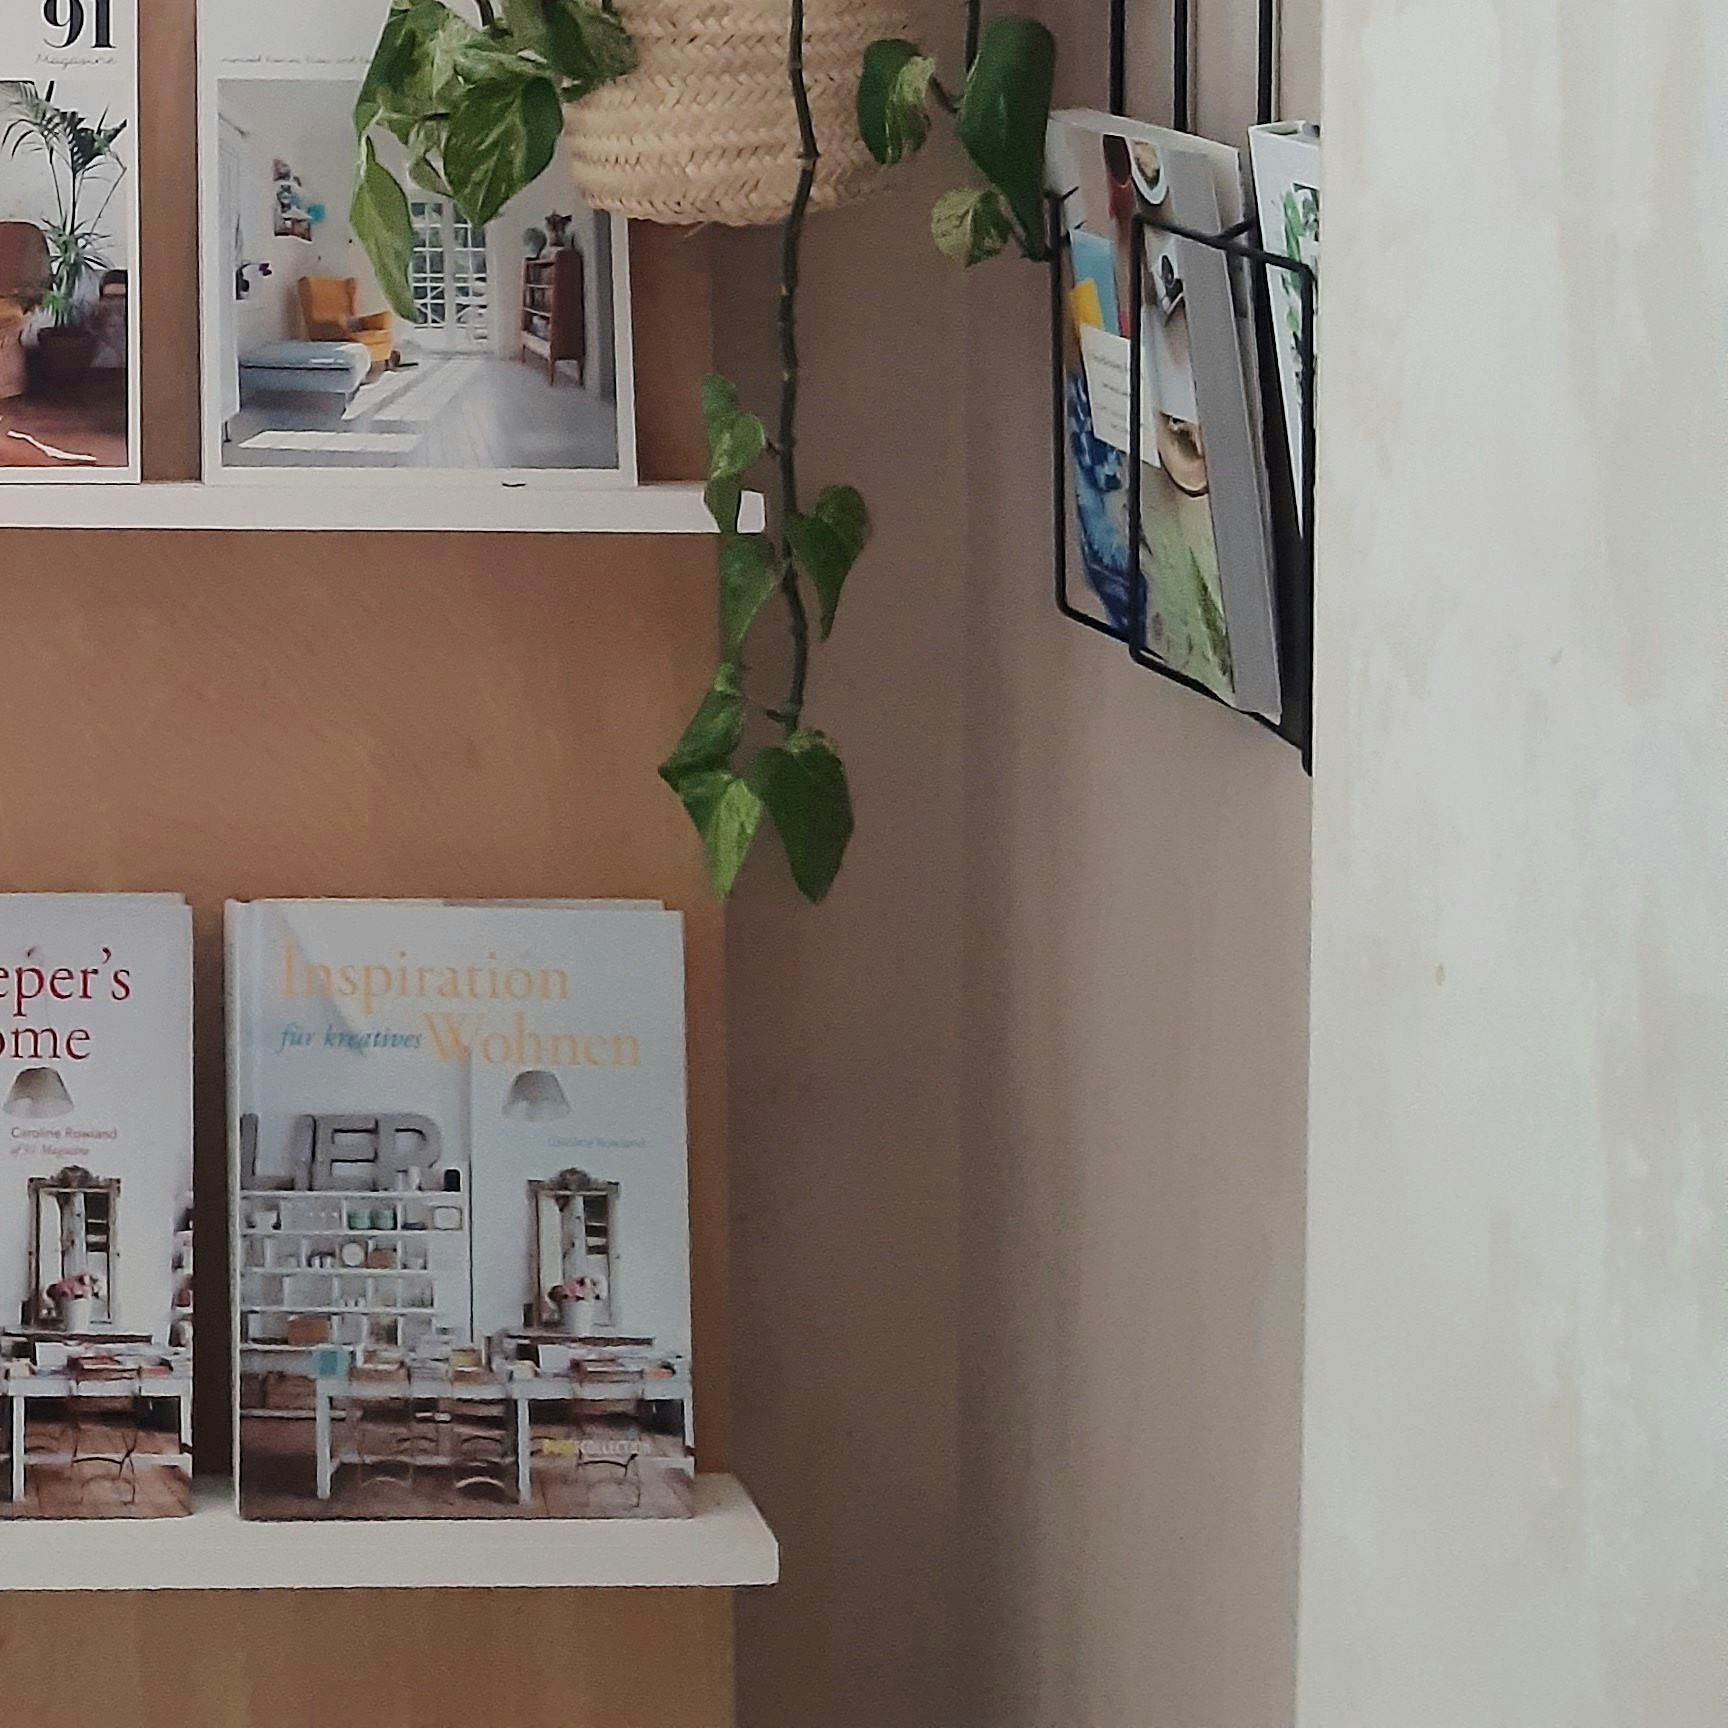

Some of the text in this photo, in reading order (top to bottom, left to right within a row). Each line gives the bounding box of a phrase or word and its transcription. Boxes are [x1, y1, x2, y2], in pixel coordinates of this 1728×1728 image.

[278, 942, 570, 1016] Inspiration
[323, 1024, 423, 1052] kreatives
[423, 1010, 641, 1068] Wohnen
